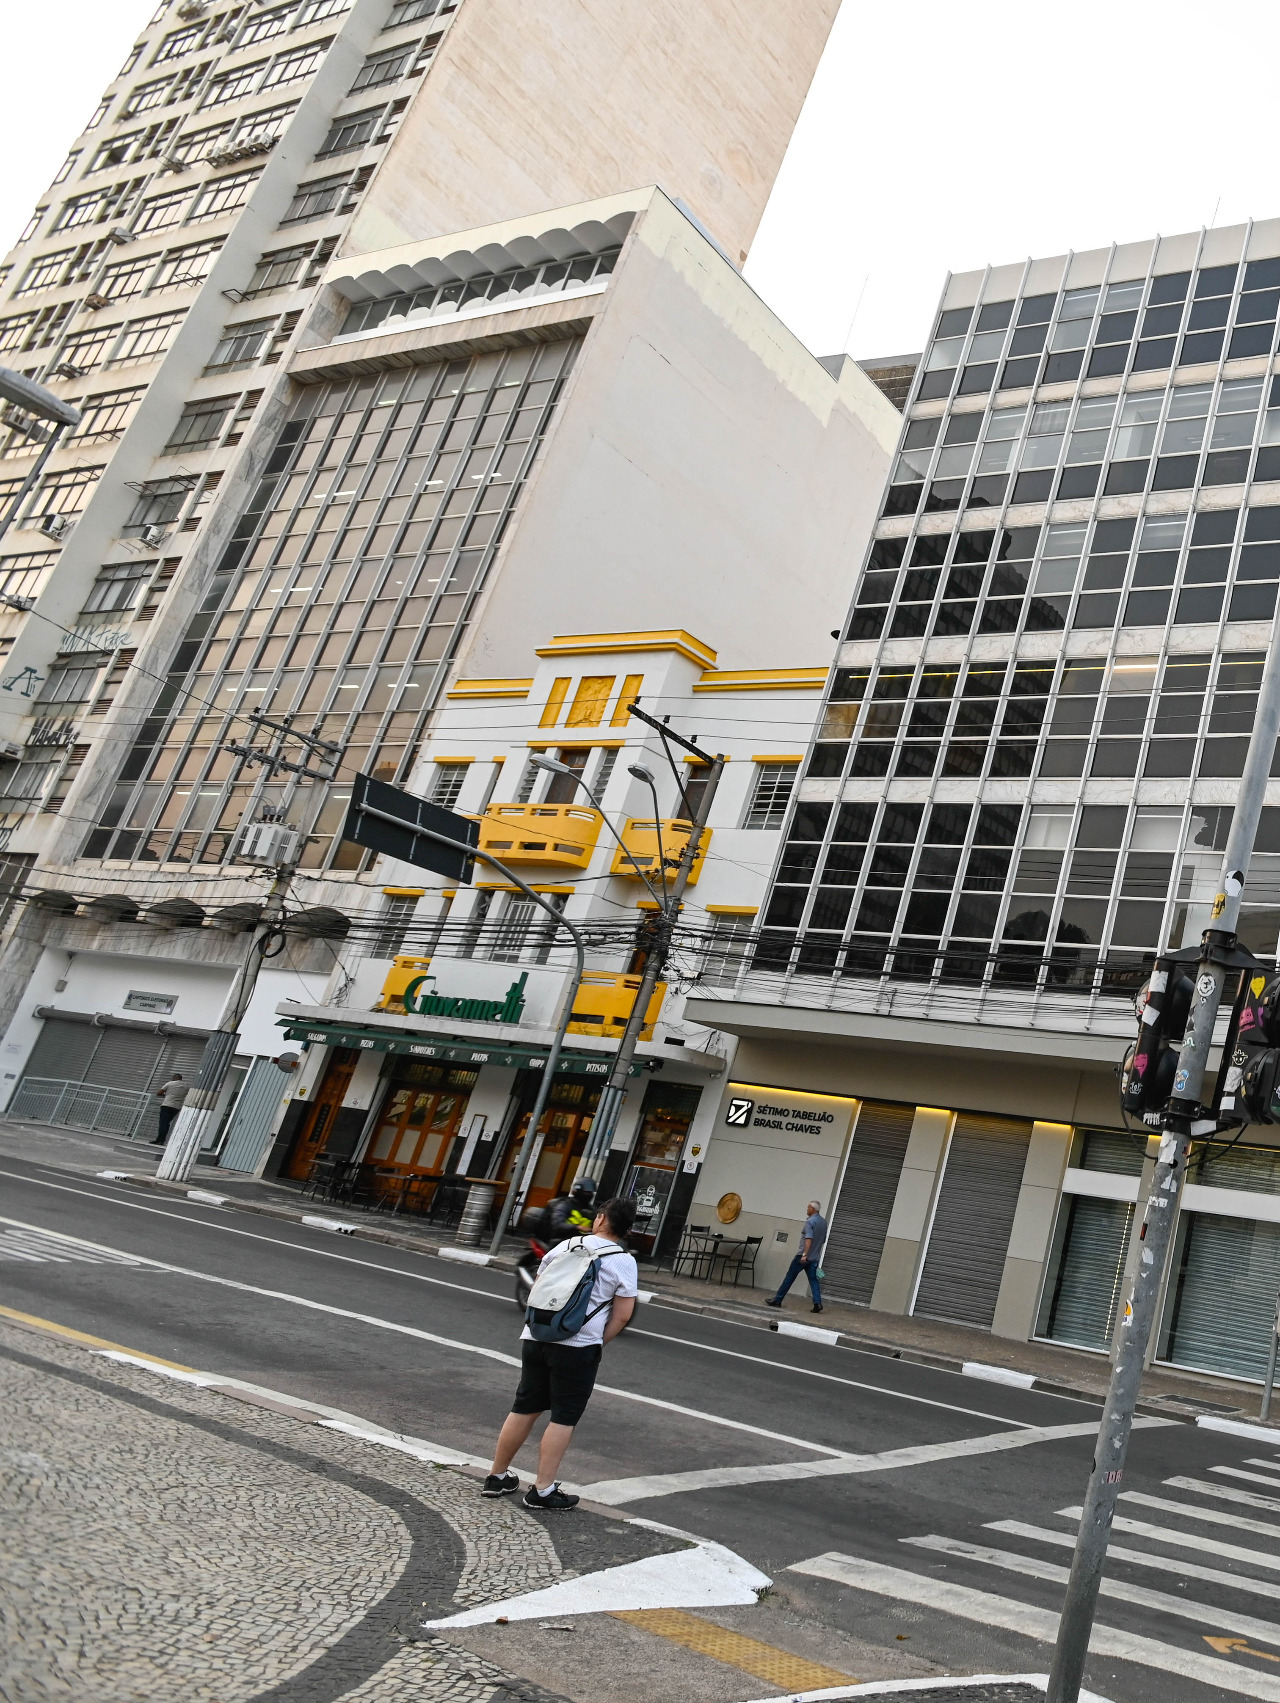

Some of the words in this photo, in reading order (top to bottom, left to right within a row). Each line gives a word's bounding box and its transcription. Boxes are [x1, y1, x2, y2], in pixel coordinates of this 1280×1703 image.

[756, 1104, 790, 1118] SÉTIMO
[791, 1109, 834, 1123] TABELIÃO
[753, 1117, 783, 1130] BRASIL
[785, 1121, 821, 1135] CHAVES
